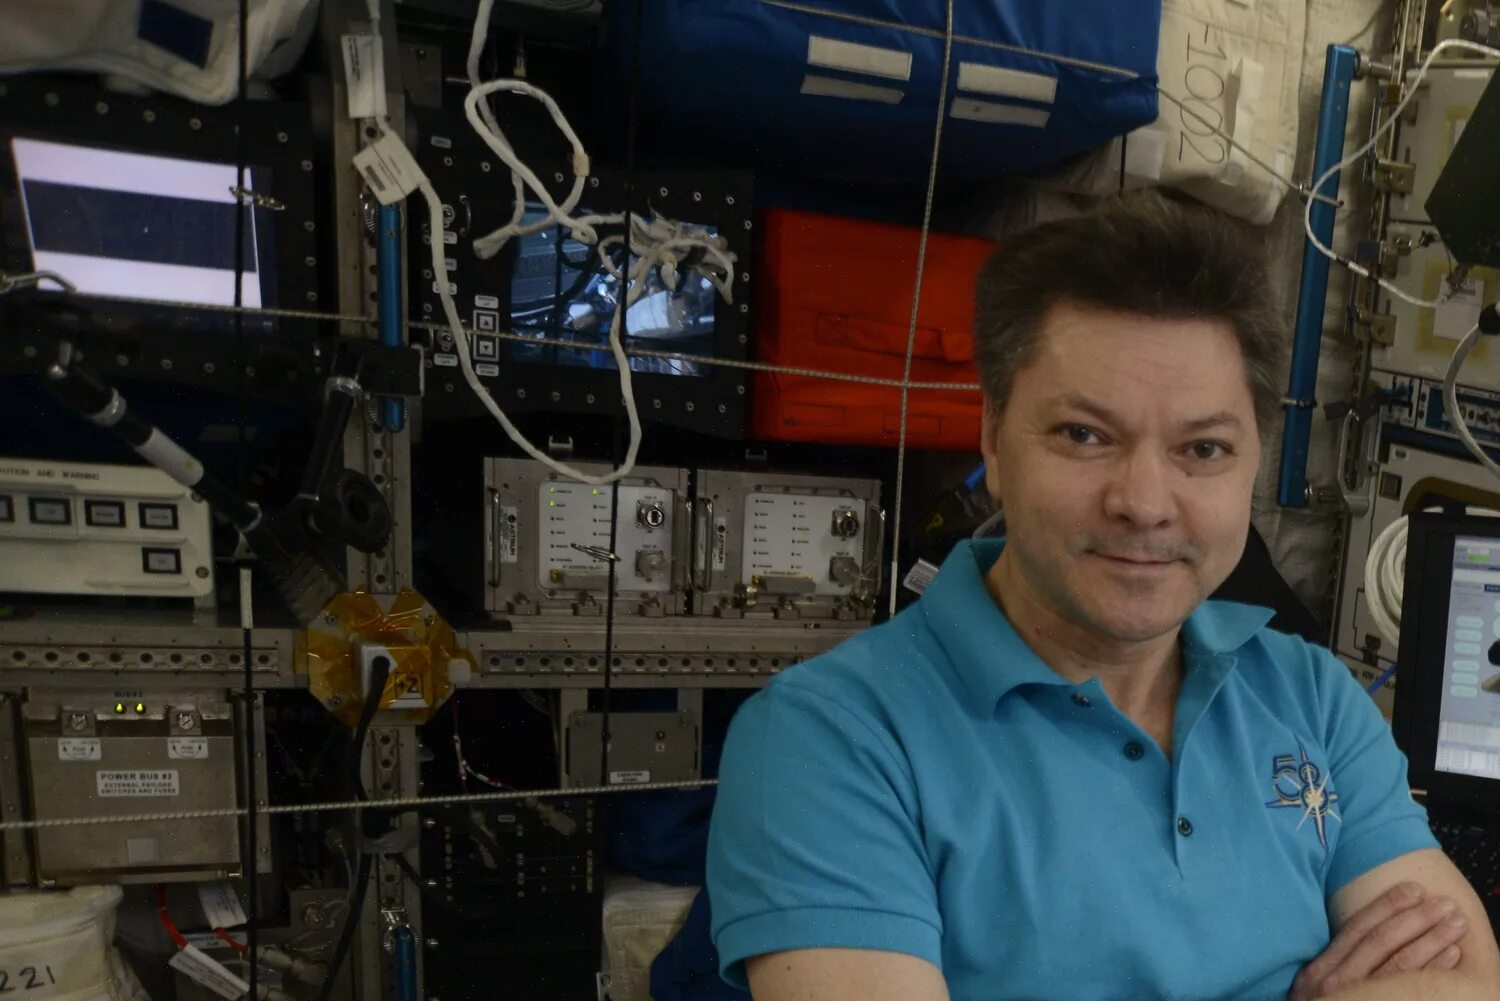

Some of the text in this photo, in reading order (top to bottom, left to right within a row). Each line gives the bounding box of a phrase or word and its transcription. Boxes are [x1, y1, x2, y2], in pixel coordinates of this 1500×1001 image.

[36, 469, 55, 478] AND
[507, 522, 518, 557] ASTRIUM
[716, 533, 726, 565] ASTRIUM
[101, 772, 173, 781] POWER BUS #2
